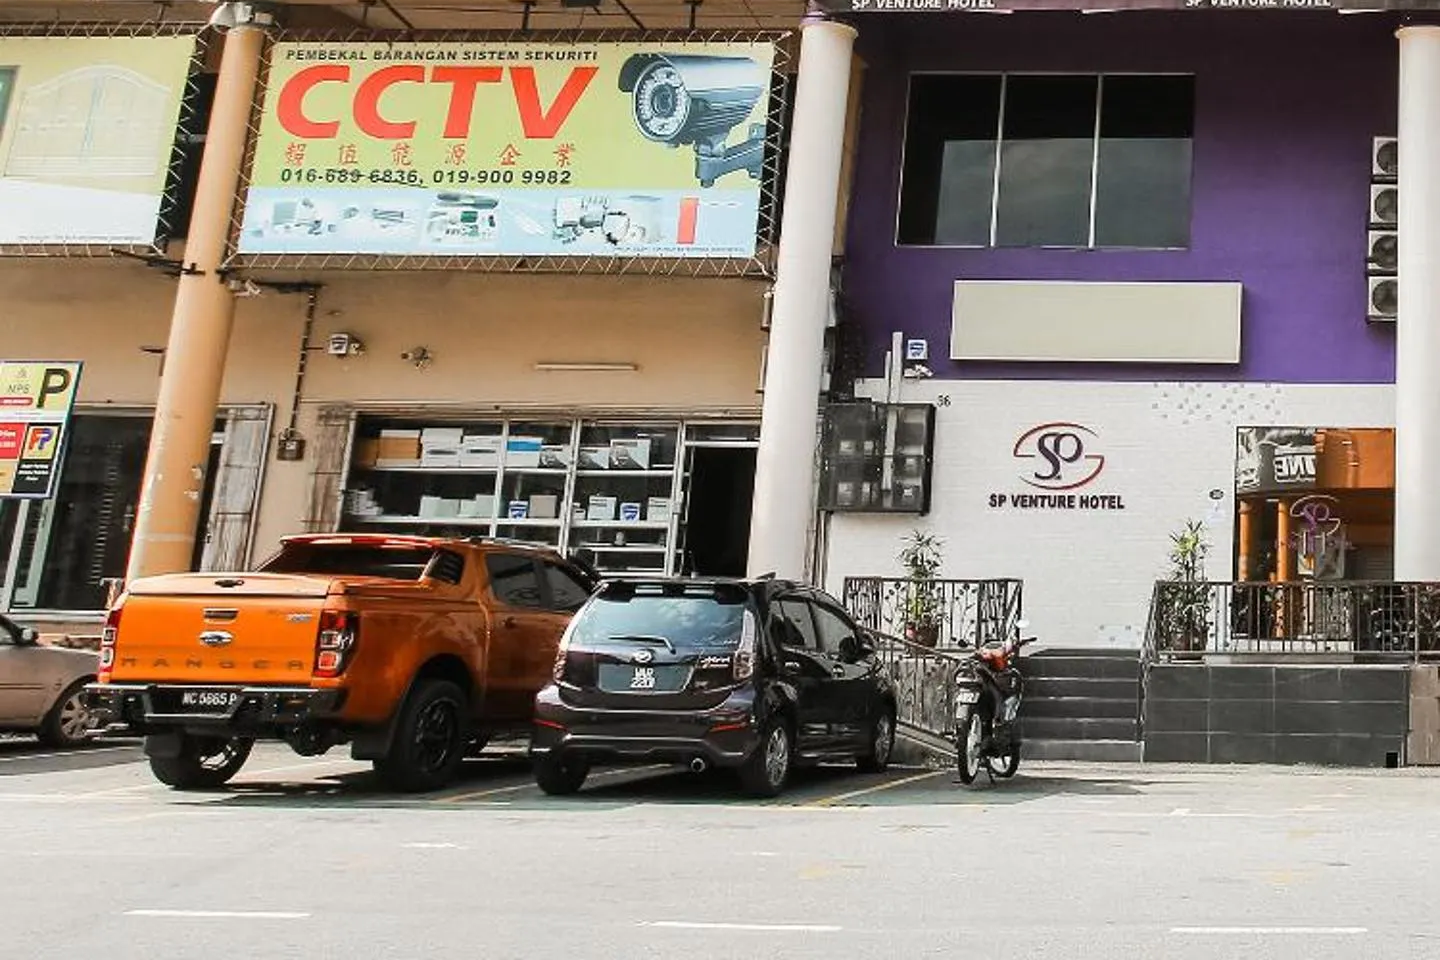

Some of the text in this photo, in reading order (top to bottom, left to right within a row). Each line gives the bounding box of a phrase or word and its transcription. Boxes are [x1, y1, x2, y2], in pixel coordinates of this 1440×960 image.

[286, 49, 598, 61] PEMBEKAL BARANGAN SISTEM SEKURITI
[276, 64, 599, 140] CCTV
[433, 169, 514, 184] 019-900
[521, 169, 572, 184] 9982
[36, 368, 71, 408] P
[989, 493, 1125, 509] SP VENTURE HOTEL
